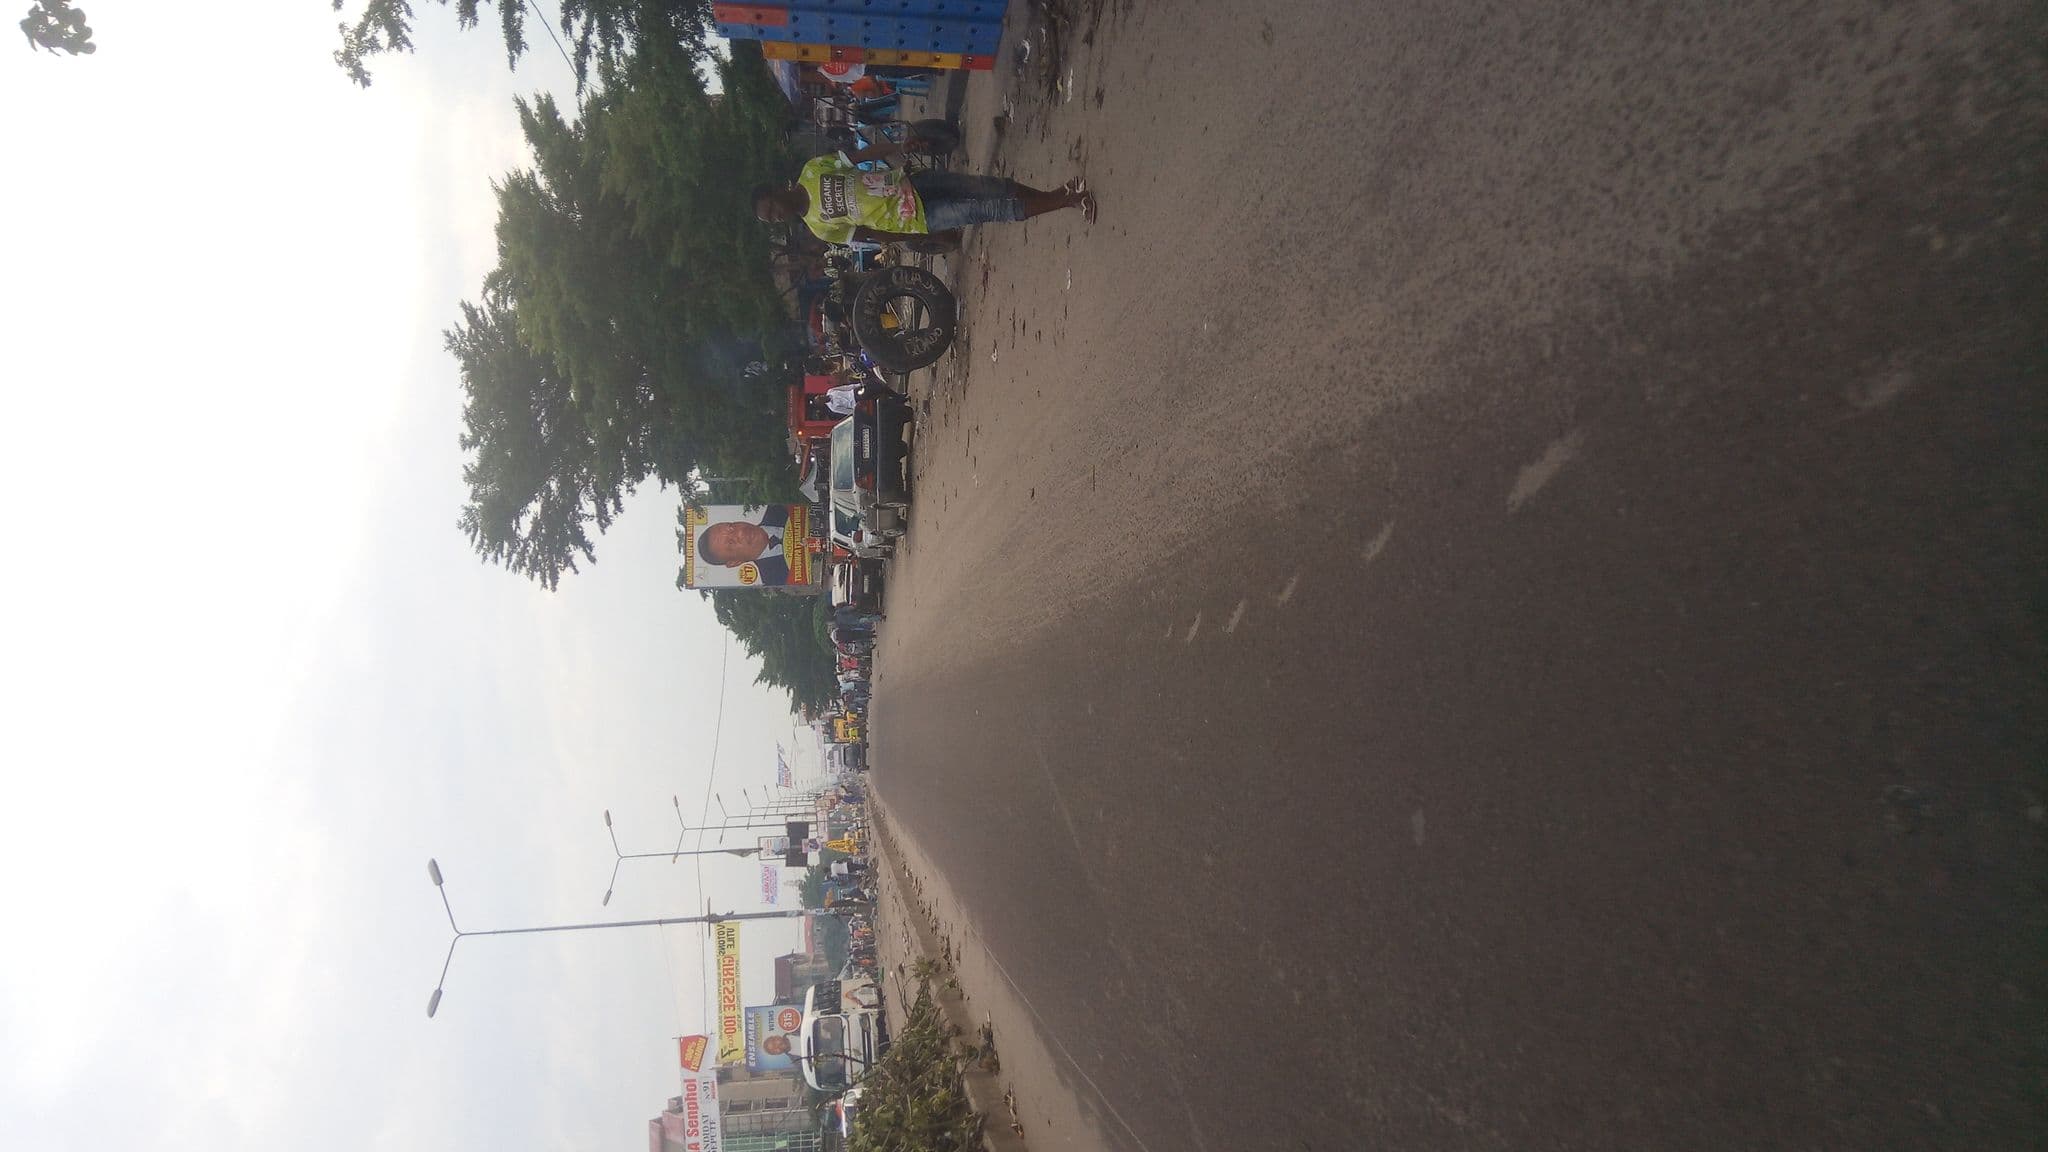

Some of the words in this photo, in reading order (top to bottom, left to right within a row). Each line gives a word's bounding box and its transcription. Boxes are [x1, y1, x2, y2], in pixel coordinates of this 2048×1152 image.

[823, 177, 834, 214] ORGANIC
[748, 1012, 756, 1067] ENSEMBLE
[784, 1013, 792, 1027] 315
[684, 1078, 699, 1137] Senphol
